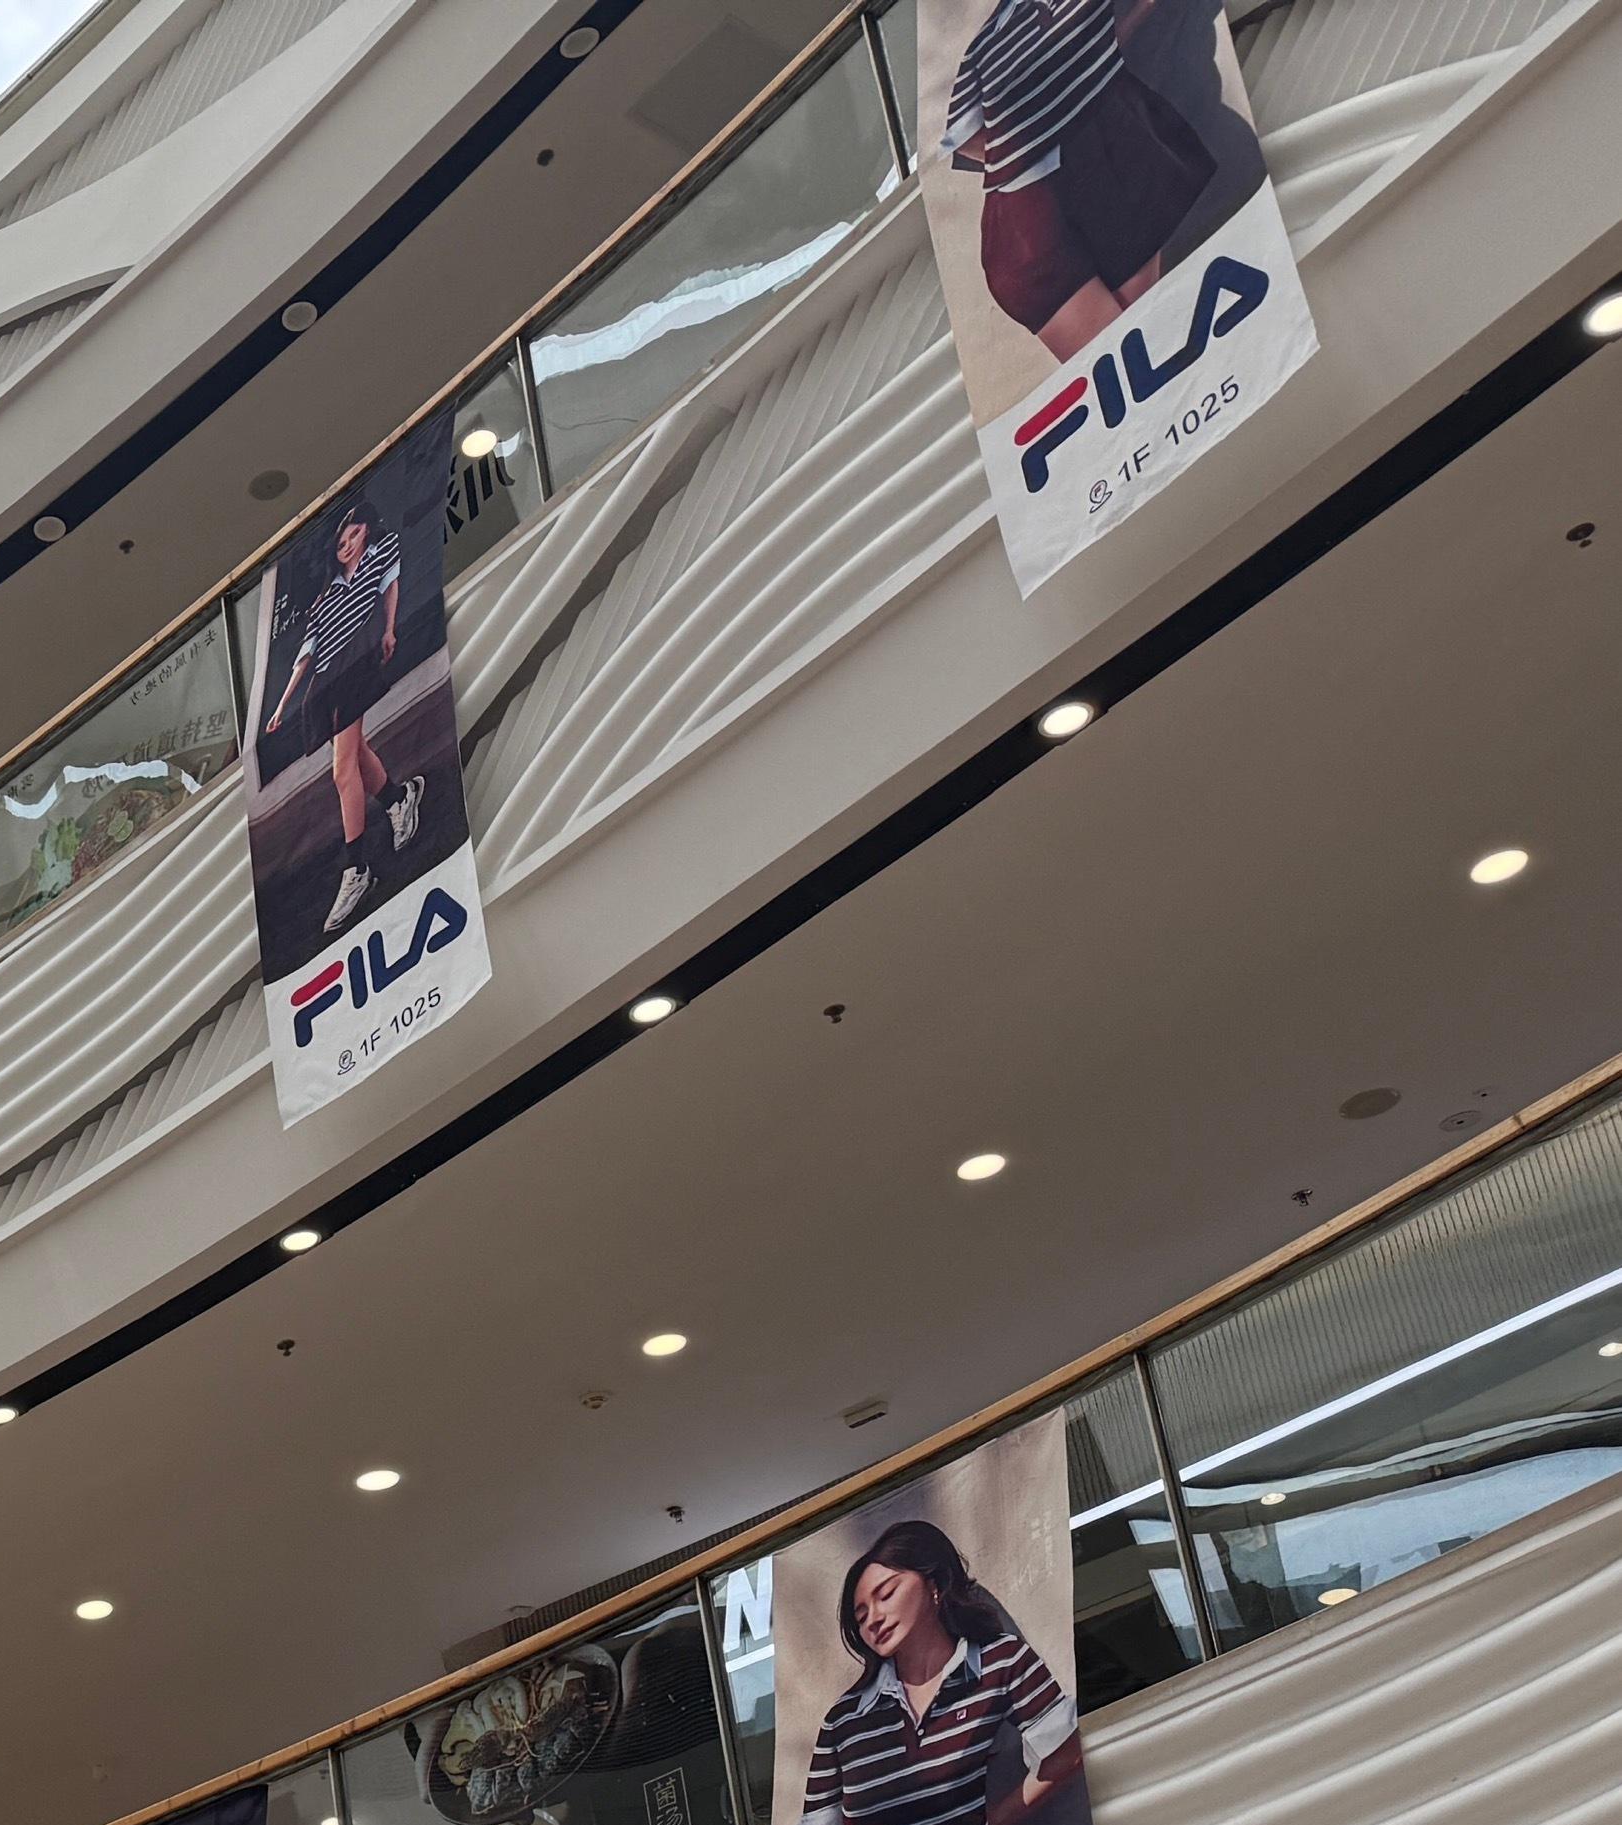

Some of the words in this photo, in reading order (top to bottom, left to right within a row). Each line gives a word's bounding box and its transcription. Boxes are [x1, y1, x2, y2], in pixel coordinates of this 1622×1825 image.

[1013, 254, 1271, 494] FILA
[1118, 443, 1150, 481] 1F
[1164, 374, 1241, 450] 1025
[290, 886, 467, 1048] FILA
[360, 1028, 380, 1056] 1F
[387, 985, 444, 1040] 1025
